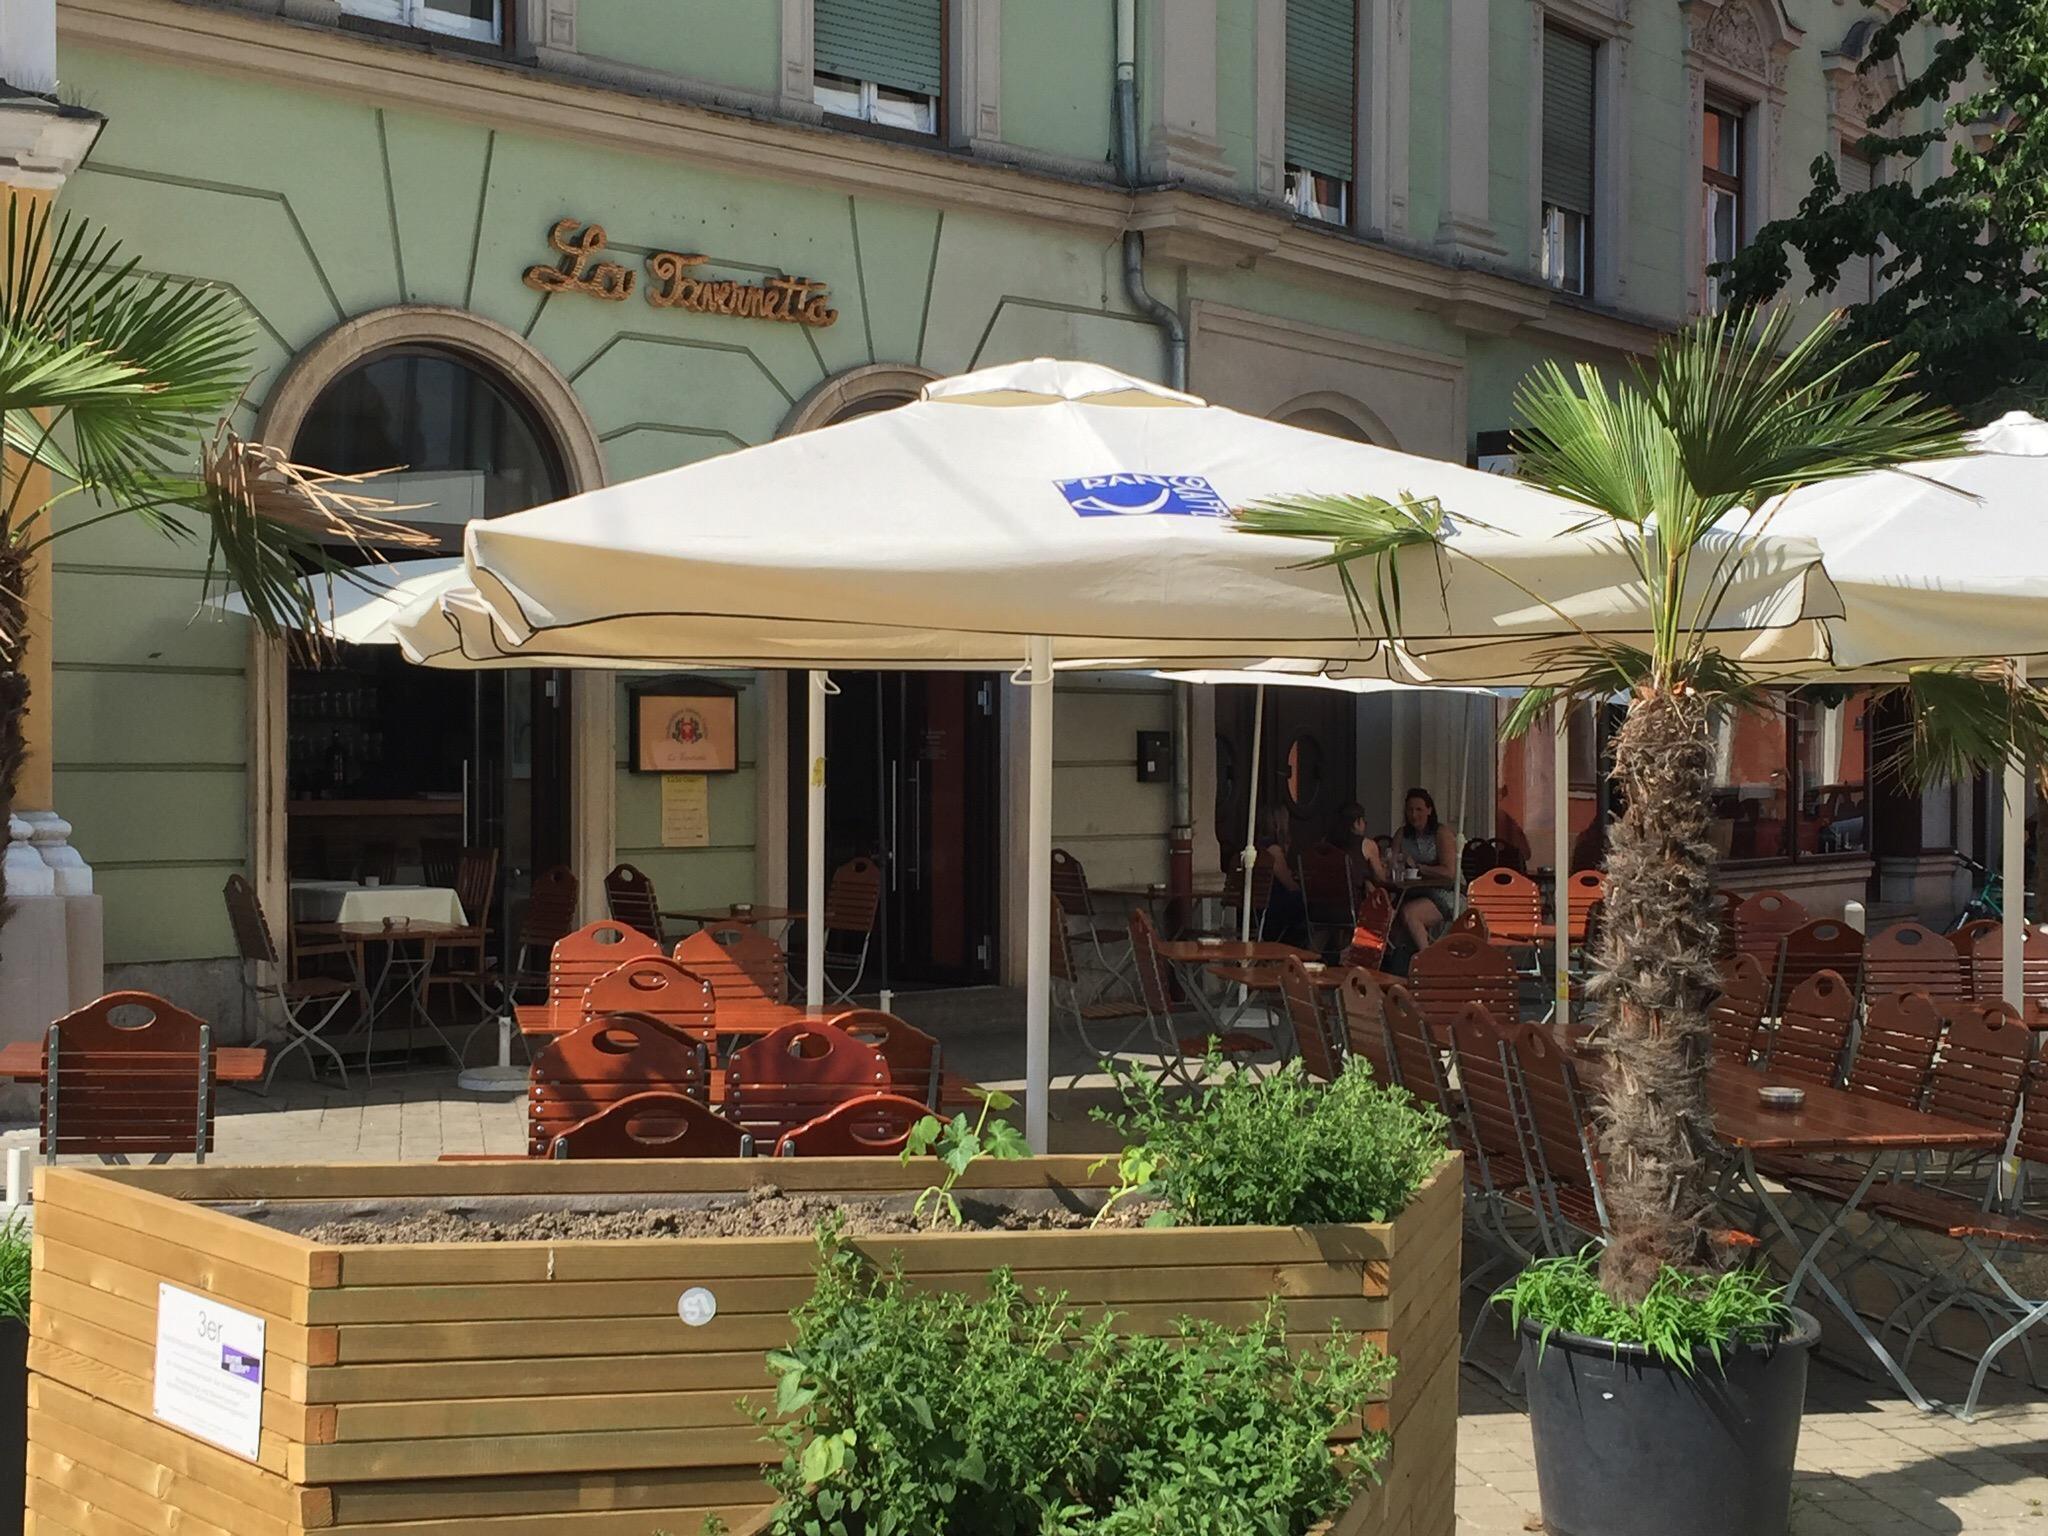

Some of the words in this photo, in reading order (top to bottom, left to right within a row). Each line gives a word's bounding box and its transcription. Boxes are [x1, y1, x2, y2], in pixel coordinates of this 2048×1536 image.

[522, 217, 637, 302] La
[645, 251, 838, 328] Tavernetta
[196, 1310, 224, 1343] 3er
